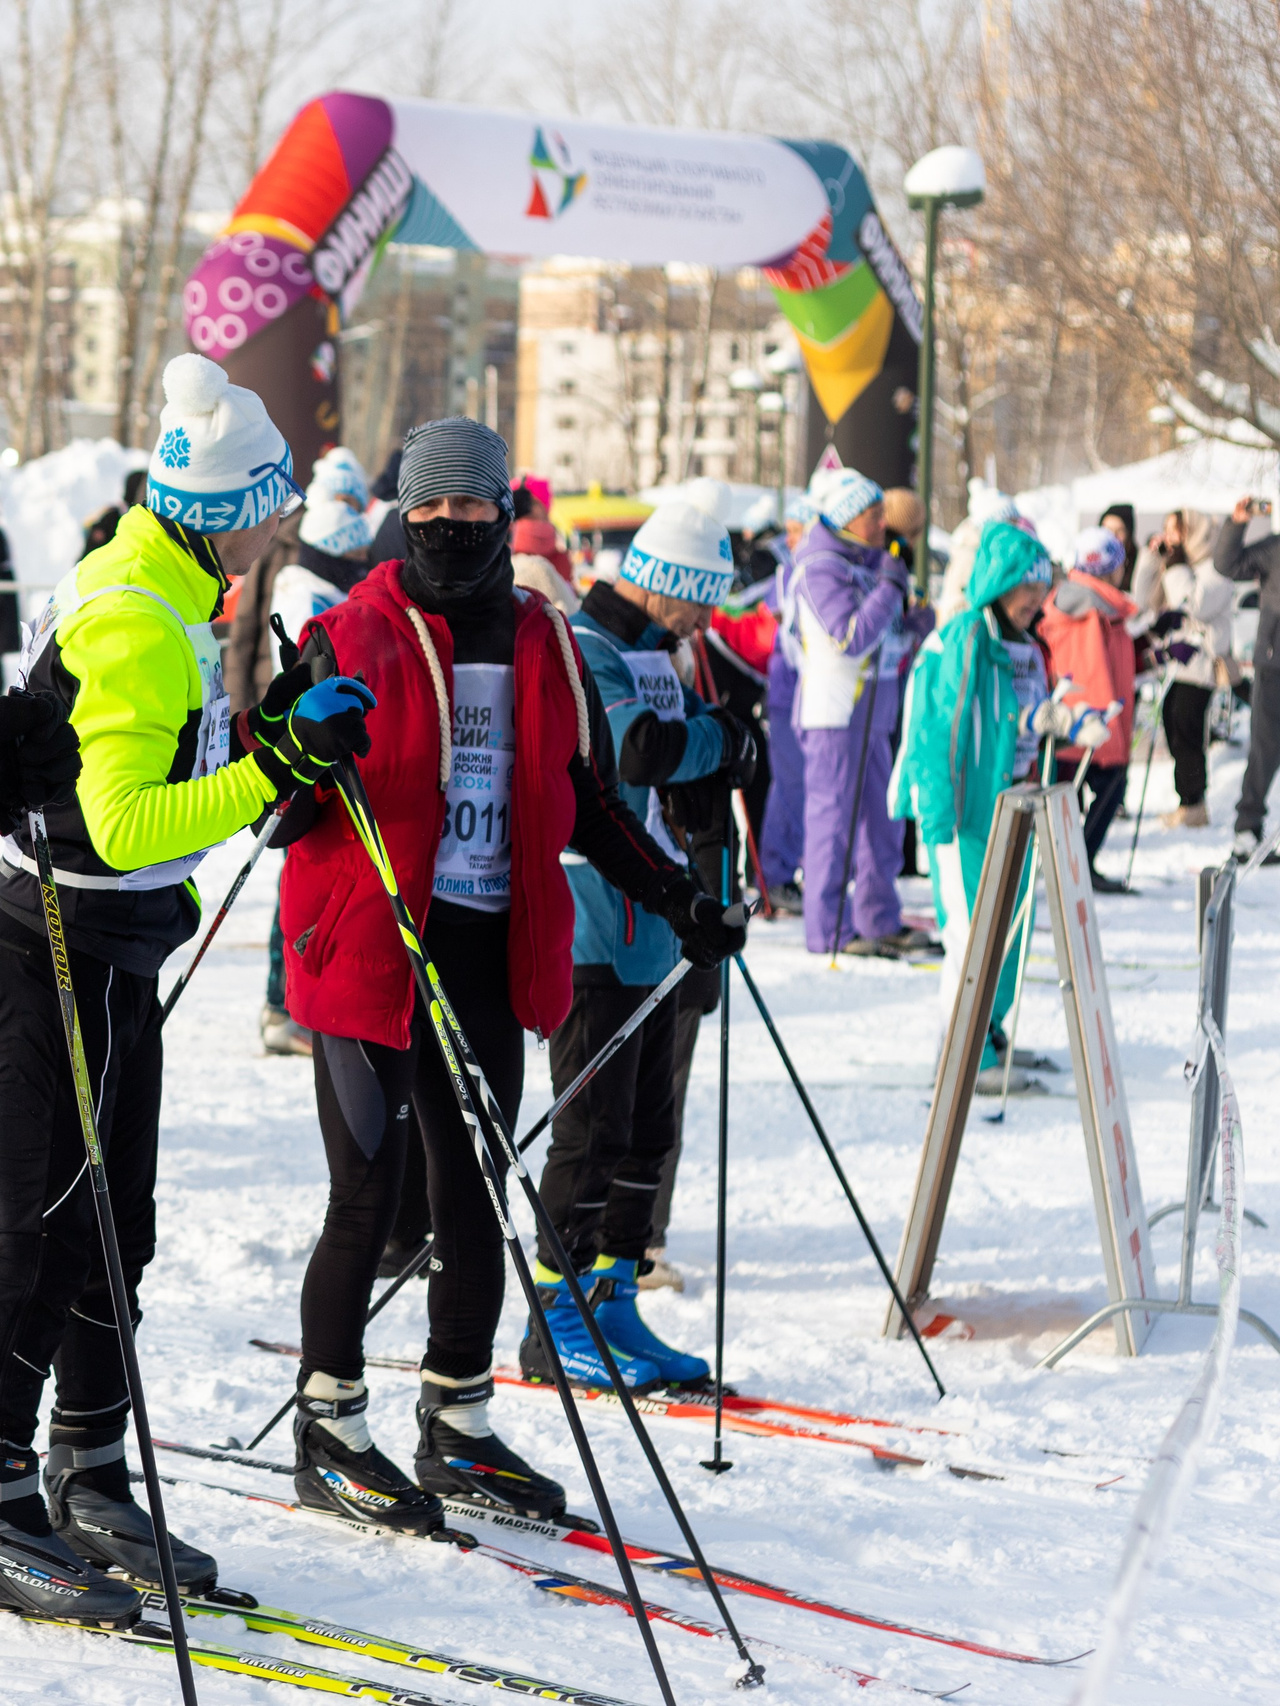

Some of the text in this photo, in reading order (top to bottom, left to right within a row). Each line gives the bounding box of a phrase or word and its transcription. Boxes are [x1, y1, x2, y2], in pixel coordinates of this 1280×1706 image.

[313, 149, 414, 292] ФИНИШ
[454, 751, 492, 764] ЛЫЖНЯ
[454, 762, 491, 775] РОССИИ
[453, 775, 492, 790] 2024
[42, 884, 72, 991] MOTOR
[495, 1123, 518, 1169] SPORT
[487, 1179, 507, 1230] SPORT
[325, 1477, 399, 1508] SALOMON
[492, 1515, 559, 1538] MADSHUS
[3, 1567, 83, 1598] SALOMON
